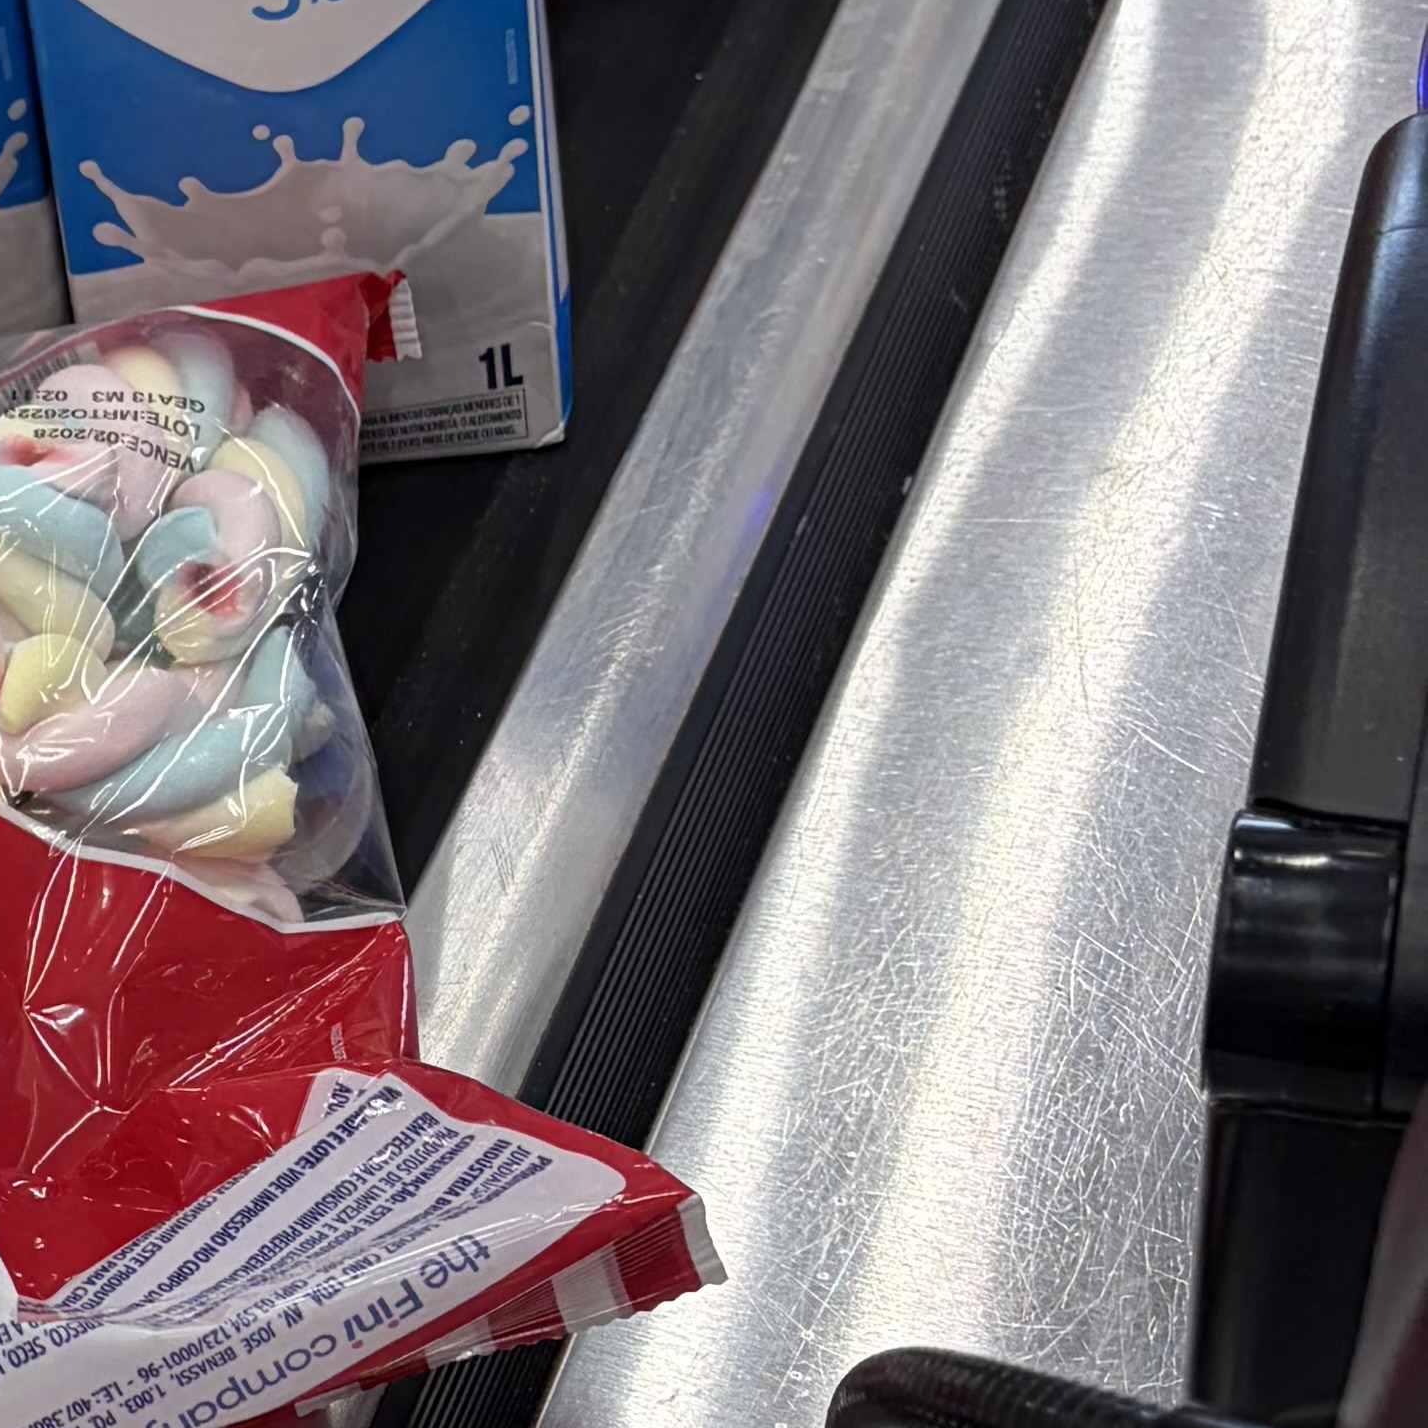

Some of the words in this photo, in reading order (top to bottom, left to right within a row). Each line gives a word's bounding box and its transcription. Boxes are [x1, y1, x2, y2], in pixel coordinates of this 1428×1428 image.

[478, 343, 524, 390] 1L
[91, 390, 124, 403] M3
[132, 390, 206, 414] GEA13
[216, 1174, 281, 1248] IMPRESSÃO
[194, 1234, 217, 1265] NO
[419, 1234, 492, 1291] the
[154, 1255, 201, 1296] CORPO
[343, 1278, 425, 1350] Fini
[2, 1338, 47, 1369] SECO,
